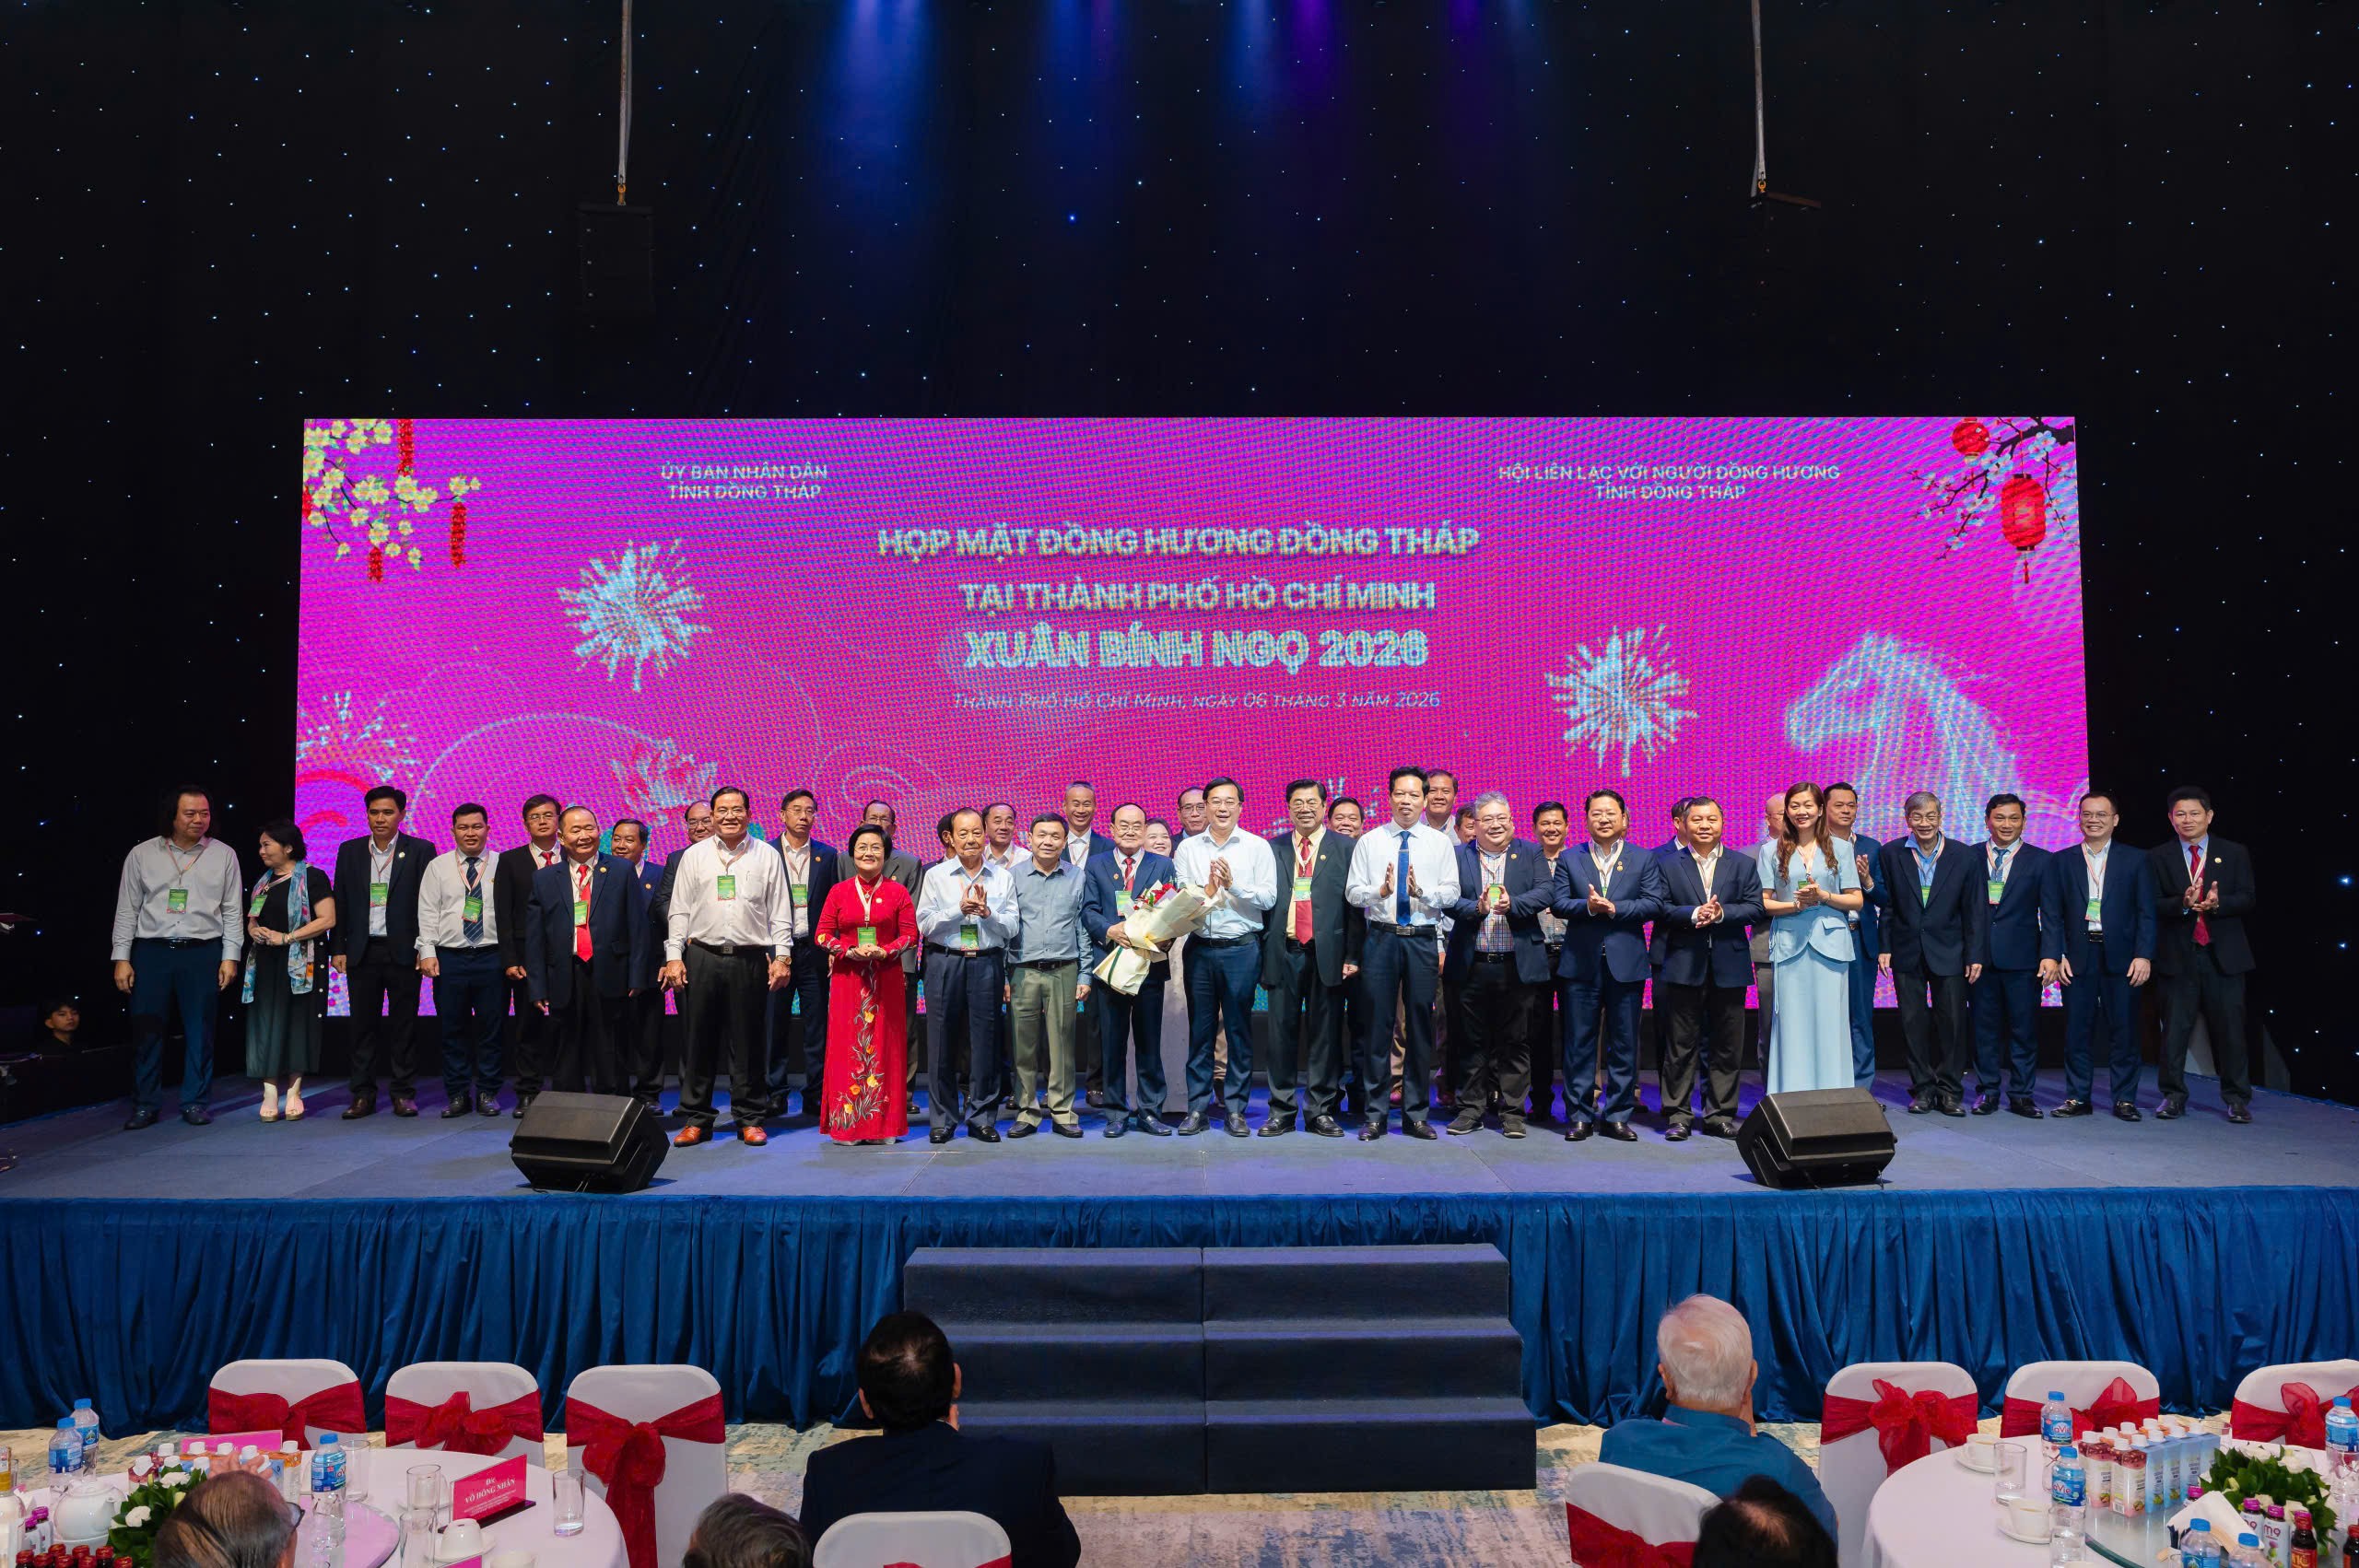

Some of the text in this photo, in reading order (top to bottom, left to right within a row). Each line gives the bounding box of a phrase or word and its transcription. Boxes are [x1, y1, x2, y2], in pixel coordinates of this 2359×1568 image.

[661, 461, 827, 479] ỦY BAN NHÂN DÂN
[1498, 462, 1840, 483] HỘI LIÊN LẠC VỚI NGƯỜI ĐỒNG HƯƠNG
[715, 481, 767, 499] ĐỒNG
[772, 481, 821, 499] THÁP
[1640, 481, 1693, 499] ĐỒNG
[1698, 482, 1745, 499] THÁP
[877, 520, 1481, 564] HỌP MẶT ĐỒNG HƯƠNG ĐỒNG THÁP
[958, 575, 1436, 616] TẠI THÀNH PHỐ HỒ CHÍ MINH
[963, 621, 1428, 675] XUÂN BÍNH NGỌ 2026
[1244, 692, 1268, 708] 06
[1335, 692, 1346, 708] 3
[1395, 691, 1441, 708] 2026
